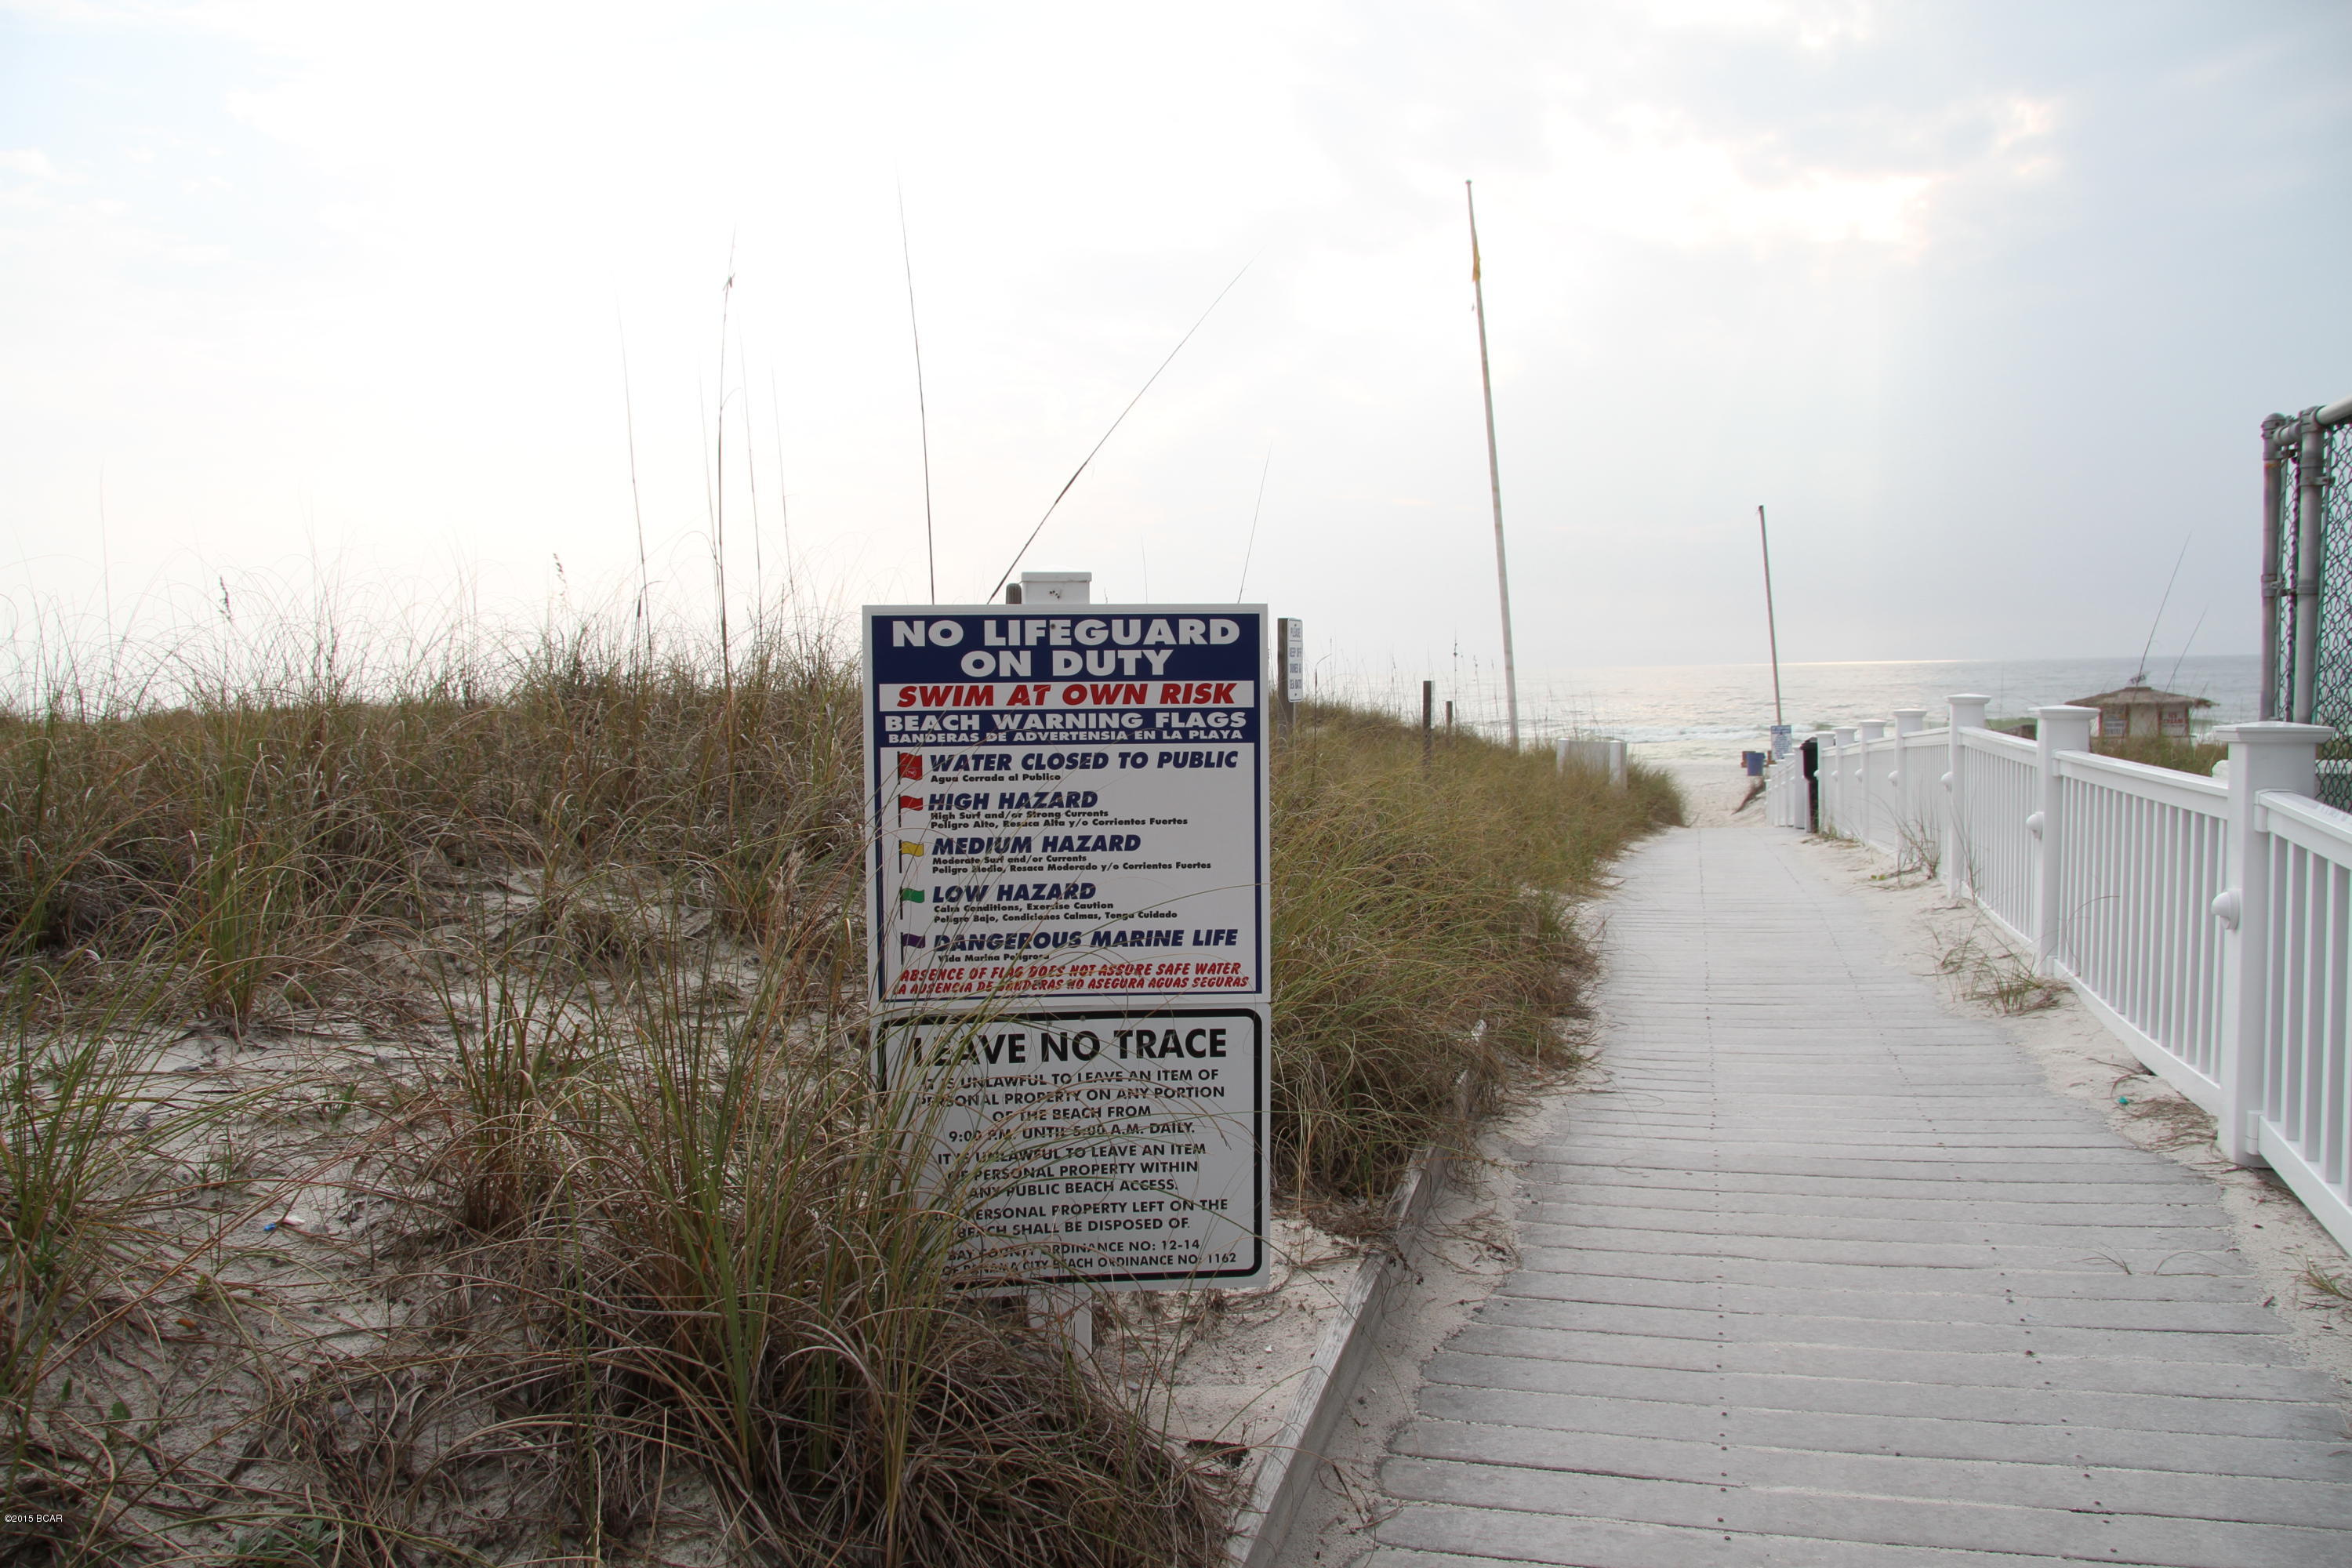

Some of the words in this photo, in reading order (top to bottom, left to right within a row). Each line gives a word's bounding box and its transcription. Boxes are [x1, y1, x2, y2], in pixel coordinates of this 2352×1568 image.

[892, 620, 964, 647] NO
[984, 619, 1240, 646] LIFEGUARD
[960, 651, 1031, 677] ON
[1052, 649, 1174, 677] DUTY
[897, 685, 995, 707] SWIM
[1007, 684, 1051, 706] AT
[1062, 684, 1148, 706] OWN
[1160, 683, 1237, 704] RISK
[885, 714, 980, 731] BEACH
[992, 713, 1143, 731] WARNING
[1156, 711, 1247, 728] FLAGS
[888, 732, 980, 743] BANDERAS
[985, 732, 1007, 742] DE
[1013, 731, 1128, 742] ADVERTENSIA
[1134, 731, 1156, 740] EN
[1163, 730, 1182, 739] LA
[1189, 730, 1243, 739] PLAYA
[930, 753, 1012, 771] WATER
[1022, 752, 1109, 771] CLOSED
[1119, 751, 1149, 768] TO
[1157, 751, 1239, 768] PUBLIC
[931, 775, 958, 784] Agua
[963, 774, 1004, 782] Cerrada
[1022, 773, 1061, 782] Publico
[928, 793, 989, 811] HIGH
[998, 791, 1098, 809] HAZARD
[931, 812, 955, 822] High
[985, 811, 1022, 819] and/or
[1026, 811, 1061, 819] Strong
[931, 821, 969, 830] Peligro
[1069, 818, 1088, 828] y/o
[931, 837, 1032, 855] MEDIUM
[1041, 834, 1141, 853] HAZARD
[932, 866, 968, 875] Peligro
[1101, 862, 1120, 872] y/o
[932, 884, 989, 903] LOW
[996, 883, 1096, 901] HAZARD
[964, 903, 1022, 912] Conditions,
[973, 914, 999, 924] Bajo,
[1063, 912, 1102, 920] Calmas,
[1105, 912, 1134, 920] Tenga
[934, 931, 1082, 952] DANGEROUS
[1091, 930, 1185, 948] MARINE
[1192, 929, 1238, 946] LIFE
[901, 967, 965, 982] ABSENCE
[969, 967, 988, 979] OF
[990, 966, 1024, 979] FLAG
[1029, 965, 1065, 978] DOES
[1069, 964, 1096, 977] NOT
[1098, 964, 1152, 976] ASSURE
[1156, 963, 1191, 975] SAFE
[1195, 962, 1241, 975] WATER
[910, 982, 972, 995] AUSENCIA
[976, 981, 994, 993] DE
[1088, 978, 1145, 989] ASEGURA
[1148, 977, 1189, 989] AGUAS
[1192, 976, 1249, 988] SEGURAS
[1041, 1031, 1100, 1062] NO
[1114, 1029, 1226, 1059] TRACE
[961, 1074, 1047, 1089] UNLAWFUL
[1051, 1073, 1072, 1085] TO
[1078, 1071, 1123, 1083] LEAVE
[1128, 1070, 1151, 1082] AN
[1157, 1069, 1192, 1081] ITEM
[1198, 1069, 1218, 1080] OF
[1004, 1091, 1081, 1105] PROPERTY
[1086, 1089, 1111, 1101] ON
[1117, 1087, 1149, 1099] ANY
[1154, 1086, 1225, 1098] PORTION
[993, 1110, 1013, 1123] OF
[1020, 1109, 1047, 1121] THE
[1053, 1107, 1102, 1120] BEACH
[1108, 1105, 1151, 1117] FROM
[1022, 1126, 1065, 1139] UNTIL
[1110, 1123, 1144, 1135] A.M.
[1150, 1122, 1195, 1134] DAILY.
[938, 1153, 951, 1165] IT
[1066, 1148, 1086, 1159] TO
[1091, 1145, 1137, 1157] LEAVE
[1142, 1145, 1164, 1156] AN
[1171, 1144, 1206, 1155] ITEM
[974, 1167, 1054, 1181] PERSONAL
[1060, 1163, 1135, 1176] PROPERTY
[1141, 1161, 1198, 1174] WITHIN
[1007, 1183, 1060, 1197] PUBLIC
[1065, 1181, 1113, 1193] BEACH
[1120, 1179, 1178, 1192] ACCESS.
[968, 1206, 1046, 1220] ERSONAL
[1052, 1202, 1127, 1215] PROPERTY
[1132, 1201, 1164, 1212] LEFT
[1170, 1200, 1194, 1211] ON
[1200, 1199, 1228, 1210] THE
[1013, 1222, 1059, 1236] SHALL
[1065, 1221, 1082, 1232] BE
[1088, 1218, 1163, 1231] DISPOSED
[1169, 1218, 1190, 1229] OF.
[979, 1247, 1034, 1259] ONTY
[1042, 1242, 1123, 1254] RDINANCE
[1129, 1241, 1156, 1251] NO:
[1161, 1240, 1200, 1250] 12-14
[1023, 1261, 1049, 1271] CITY
[1098, 1255, 1173, 1268] ORDINANCE
[1209, 1253, 1236, 1264] 1162
